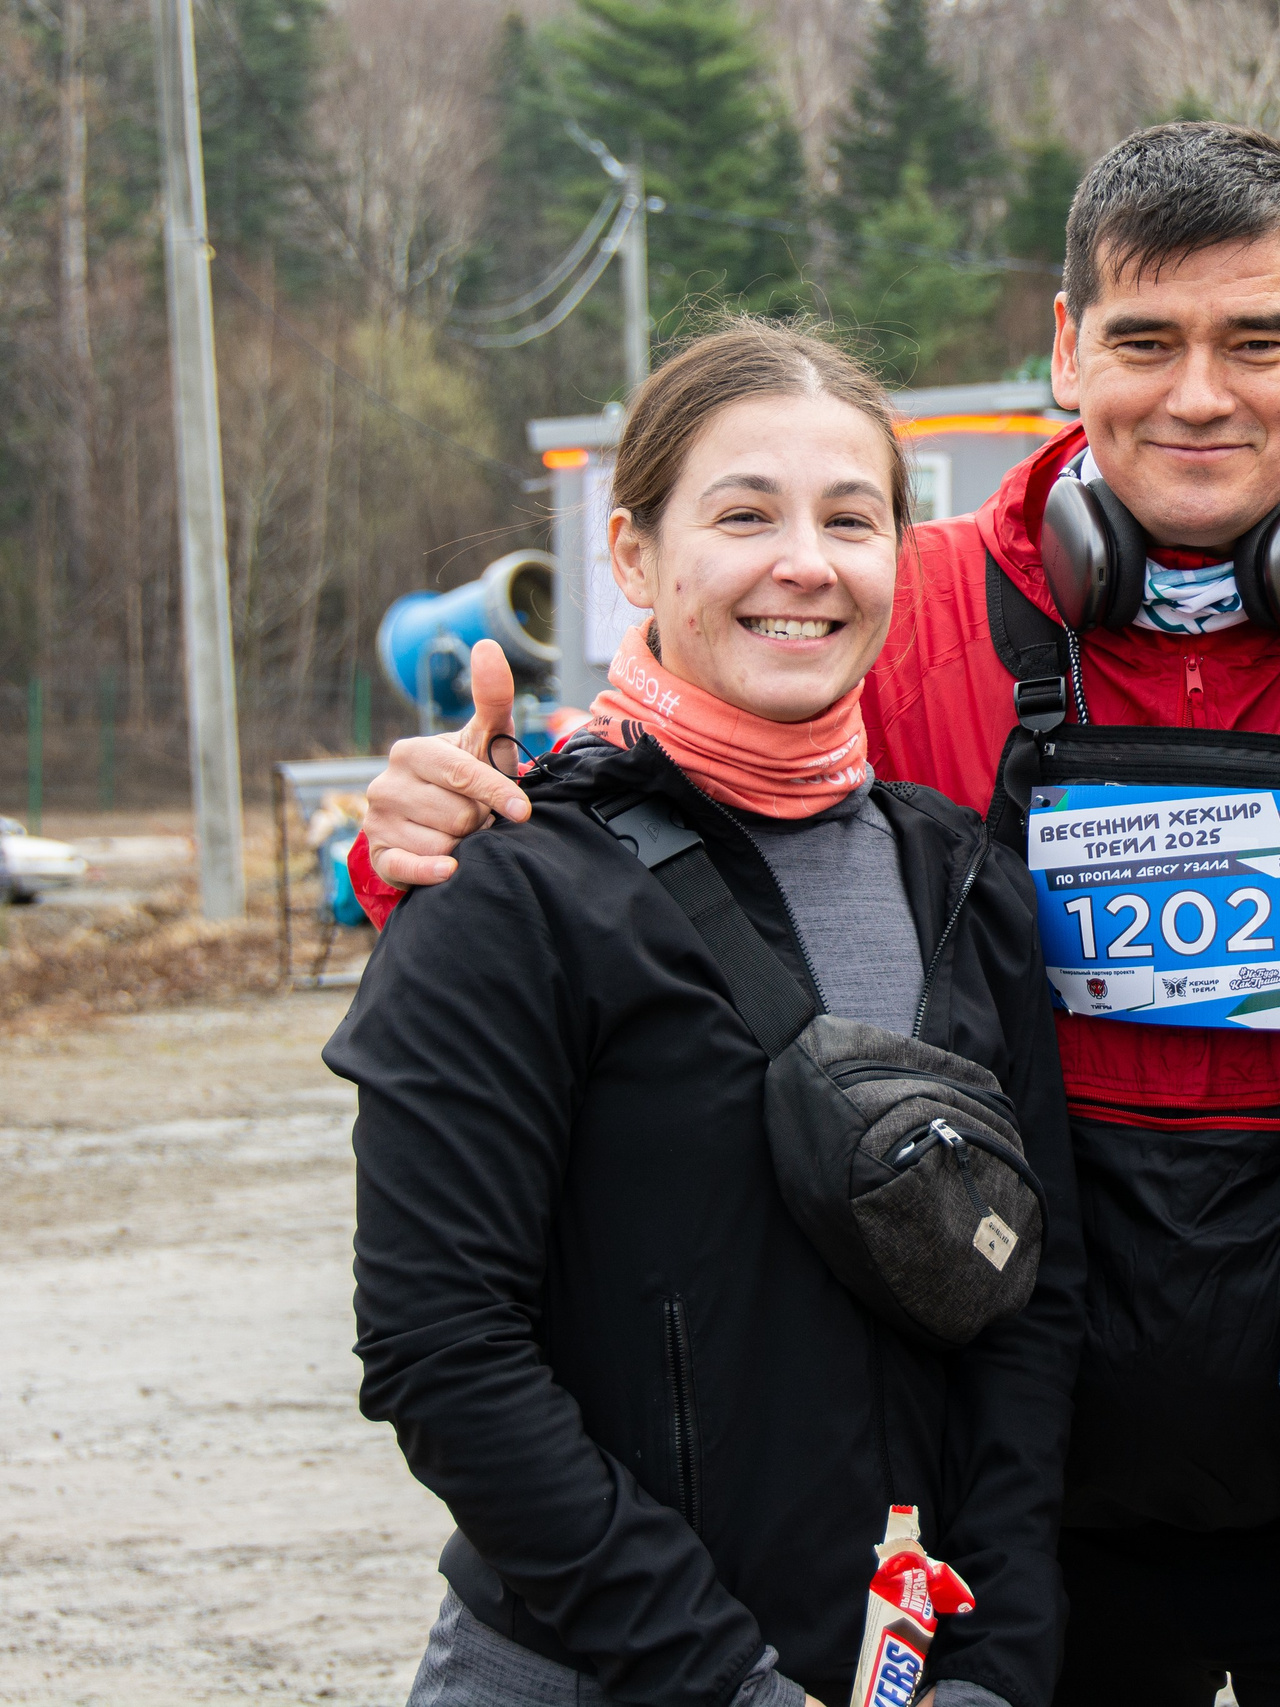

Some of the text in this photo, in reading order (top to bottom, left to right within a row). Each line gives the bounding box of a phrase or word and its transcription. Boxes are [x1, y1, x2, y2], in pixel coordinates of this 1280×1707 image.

[1040, 802, 1262, 843] ВЕСЕННИЙ ХЕХЦИР
[1083, 827, 1222, 859] ТРЕЙЛ 2025
[1056, 859, 1230, 885] ПО ТРОПАМ ДЕРСУ УЗАЛА
[1188, 979, 1220, 987] ХЕХЦИР
